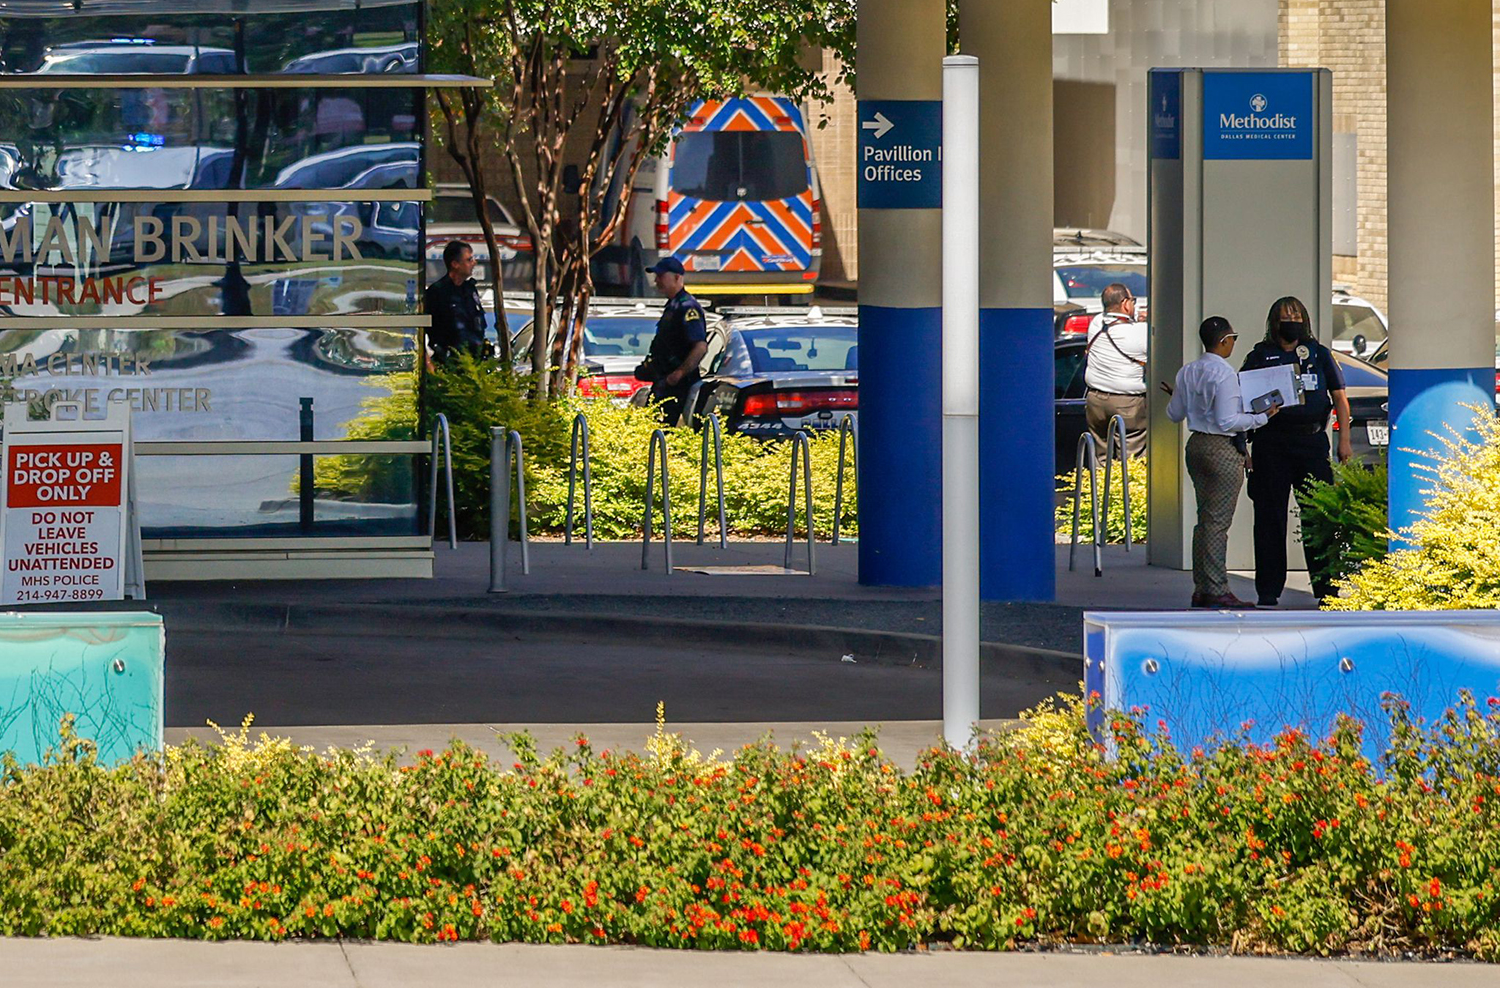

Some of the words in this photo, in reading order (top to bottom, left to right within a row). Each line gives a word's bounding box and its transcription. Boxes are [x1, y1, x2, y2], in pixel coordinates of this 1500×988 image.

[1220, 114, 1296, 128] Methodist
[864, 146, 932, 161] Pavillion
[864, 165, 921, 181] Offices
[133, 215, 364, 262] BRINKER
[47, 352, 152, 377] CENTER
[16, 453, 62, 468] PICK
[67, 452, 93, 467] UP
[99, 452, 113, 467] &
[14, 469, 70, 485] DROP
[76, 469, 115, 483] OFF
[37, 485, 91, 501] ONLY
[32, 512, 55, 525] DO
[61, 512, 94, 524] NOT
[39, 527, 85, 540] LEAVE
[25, 543, 98, 555] VEHICLES
[9, 558, 114, 571] UNATTENDED
[22, 576, 50, 586] MHS
[54, 575, 99, 585] POLICE
[17, 590, 103, 600] 214-947-8899
